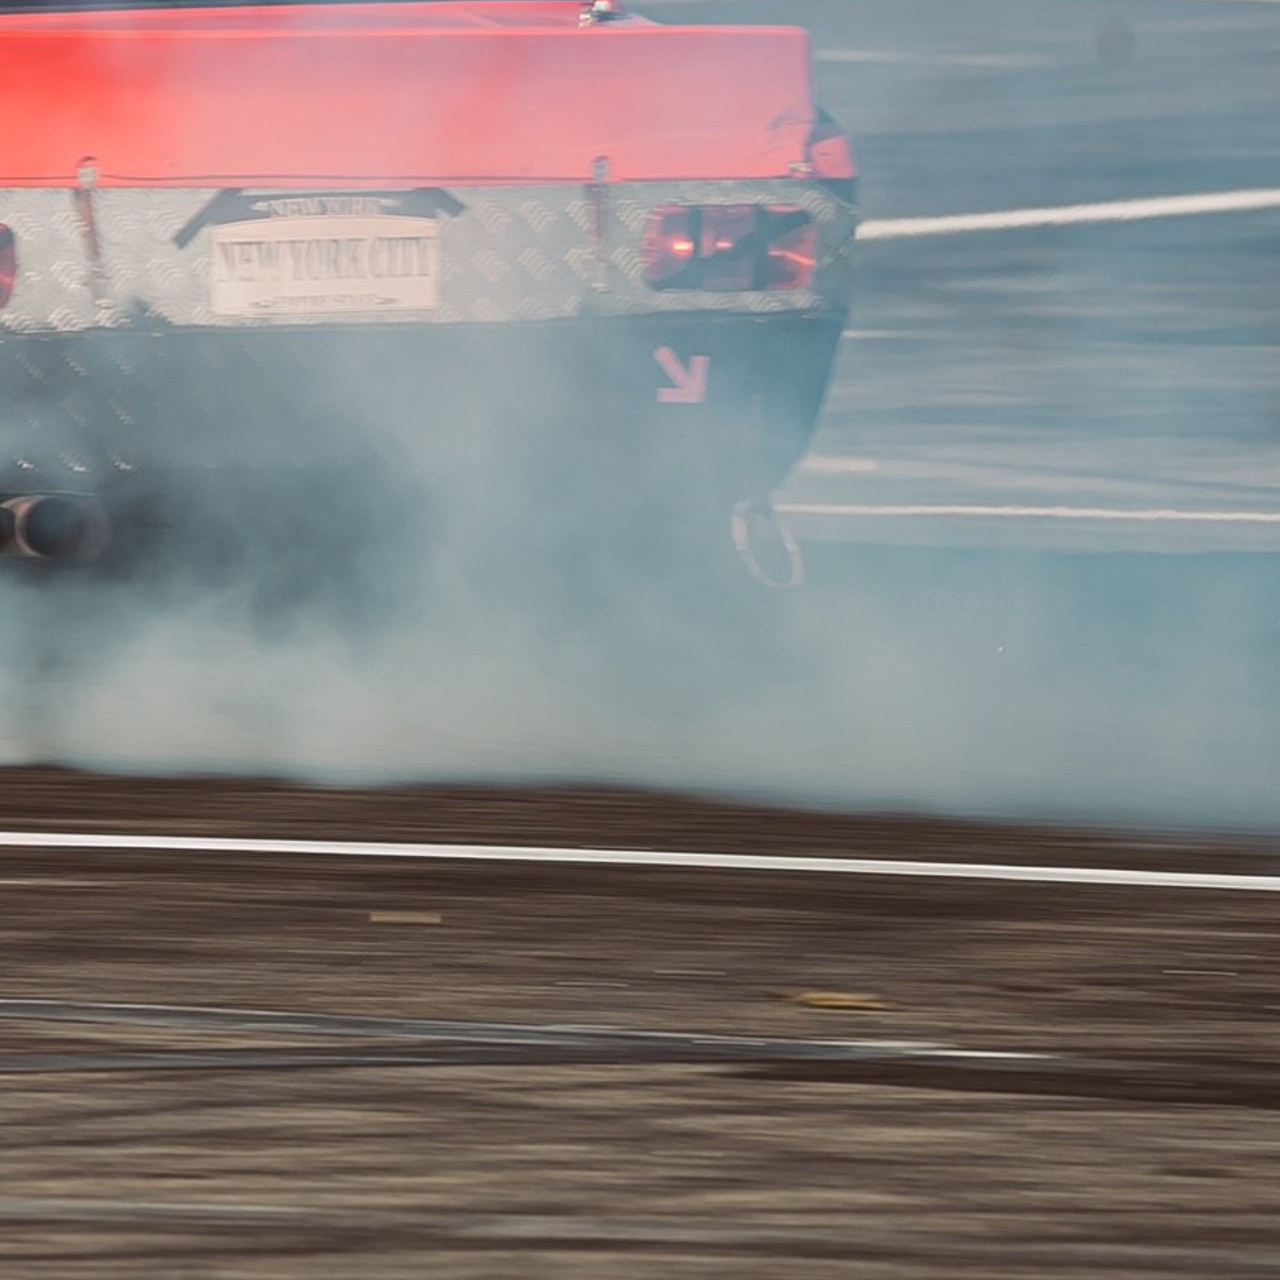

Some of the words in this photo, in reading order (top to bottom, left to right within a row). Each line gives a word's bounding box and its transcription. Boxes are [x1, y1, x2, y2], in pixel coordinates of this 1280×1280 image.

[216, 241, 287, 282] NEW
[287, 237, 369, 280] YORK
[370, 235, 436, 278] CITY
